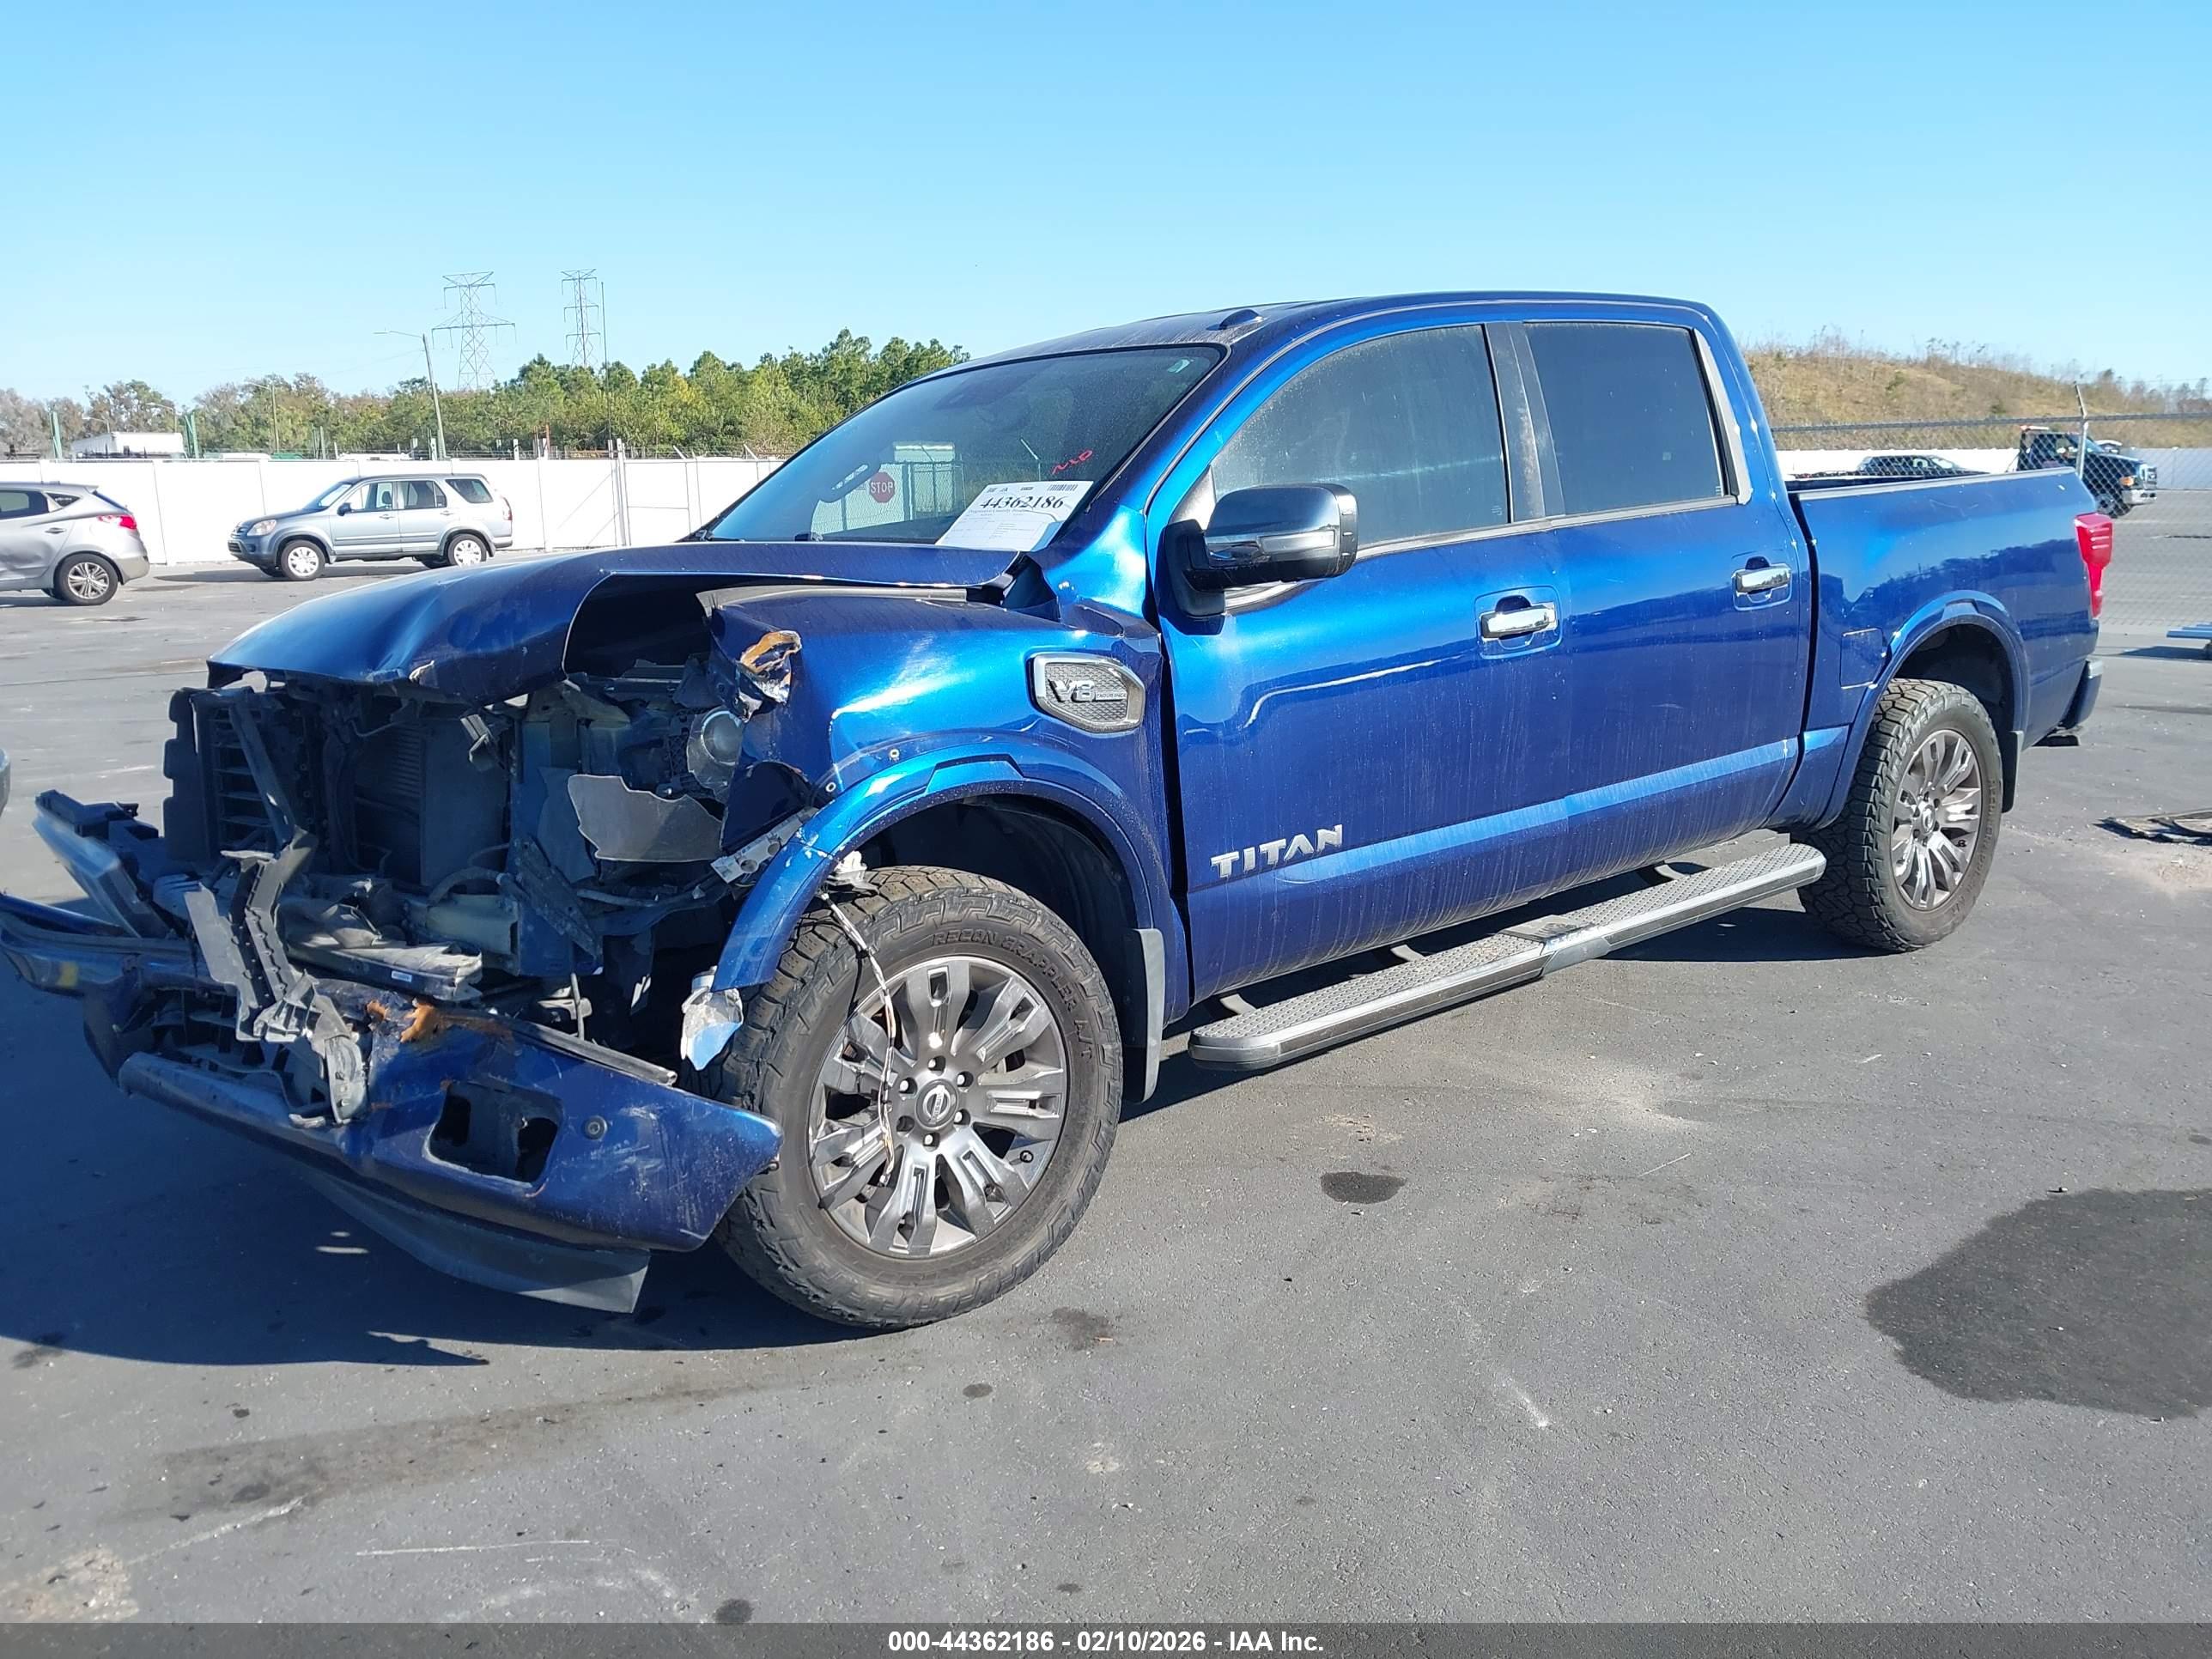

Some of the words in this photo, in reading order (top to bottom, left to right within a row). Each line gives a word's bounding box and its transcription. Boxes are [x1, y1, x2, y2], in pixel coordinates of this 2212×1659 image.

[870, 481, 894, 494] STOP
[979, 495, 1066, 509] 44362186
[1048, 679, 1096, 702] V8
[1210, 823, 1343, 878] TITAN
[931, 927, 998, 945] RECON
[1000, 935, 1078, 1012] GRAPPLER
